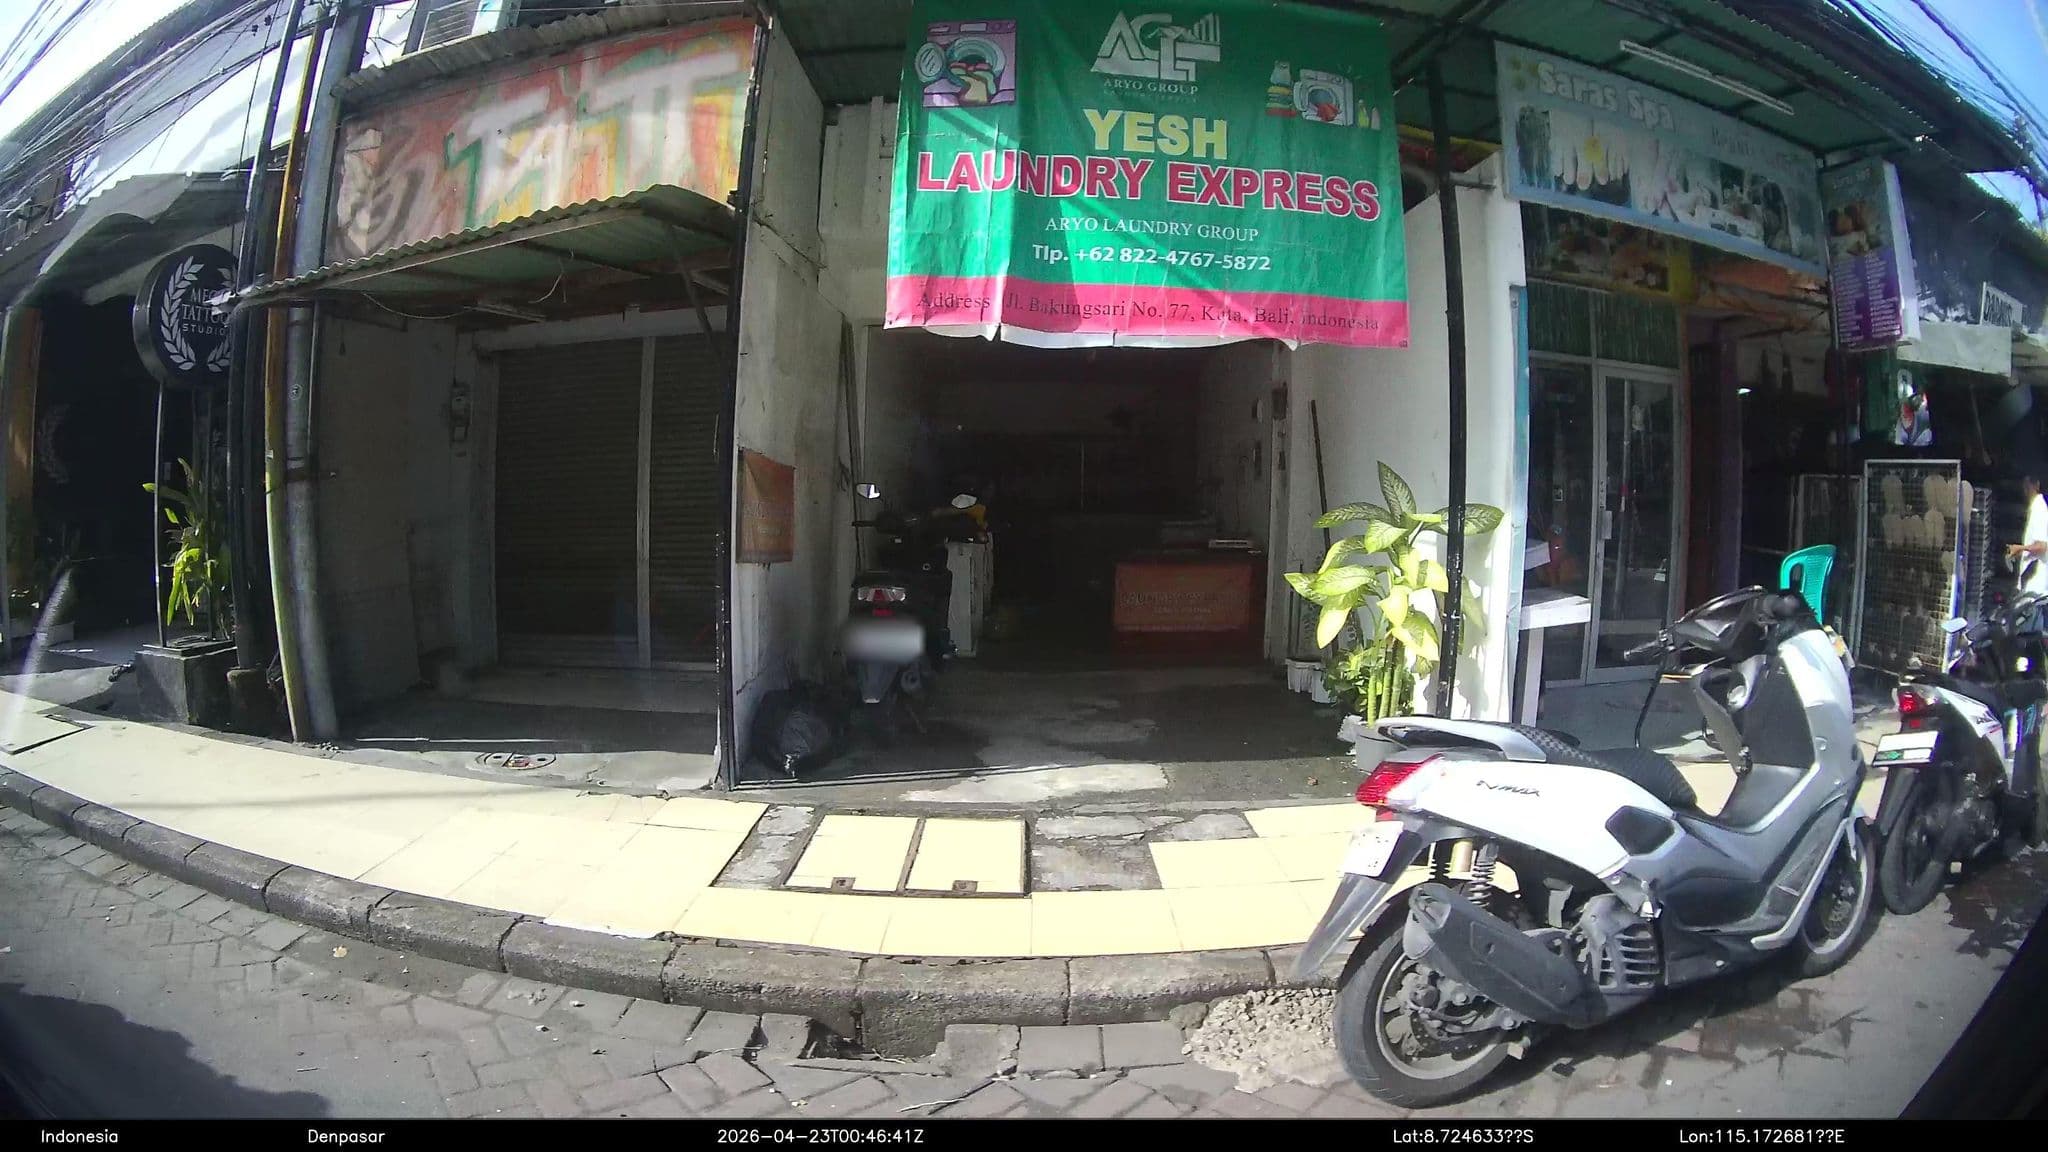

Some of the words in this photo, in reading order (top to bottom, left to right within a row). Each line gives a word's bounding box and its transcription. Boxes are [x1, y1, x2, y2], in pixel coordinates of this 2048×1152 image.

[1103, 77, 1143, 91] ARYO
[1147, 81, 1199, 96] GROUP
[1537, 61, 1618, 113] Saras
[1626, 89, 1677, 133] Spa
[1083, 107, 1228, 160] YESH
[916, 149, 1154, 201] LAUNDRY
[1167, 161, 1381, 222] EXPRESS
[1045, 217, 1098, 232] ARYO
[1102, 217, 1194, 237] LAUNDRY
[1197, 223, 1259, 242] GROUP
[1032, 243, 1069, 265] Tlp.
[1074, 246, 1114, 263] +62
[1119, 246, 1271, 271] 822-4767-5872
[1029, 297, 1125, 321] Bakungsari
[1132, 301, 1163, 319] No.
[1169, 303, 1195, 322] 77,
[182, 323, 225, 336] STUDIO
